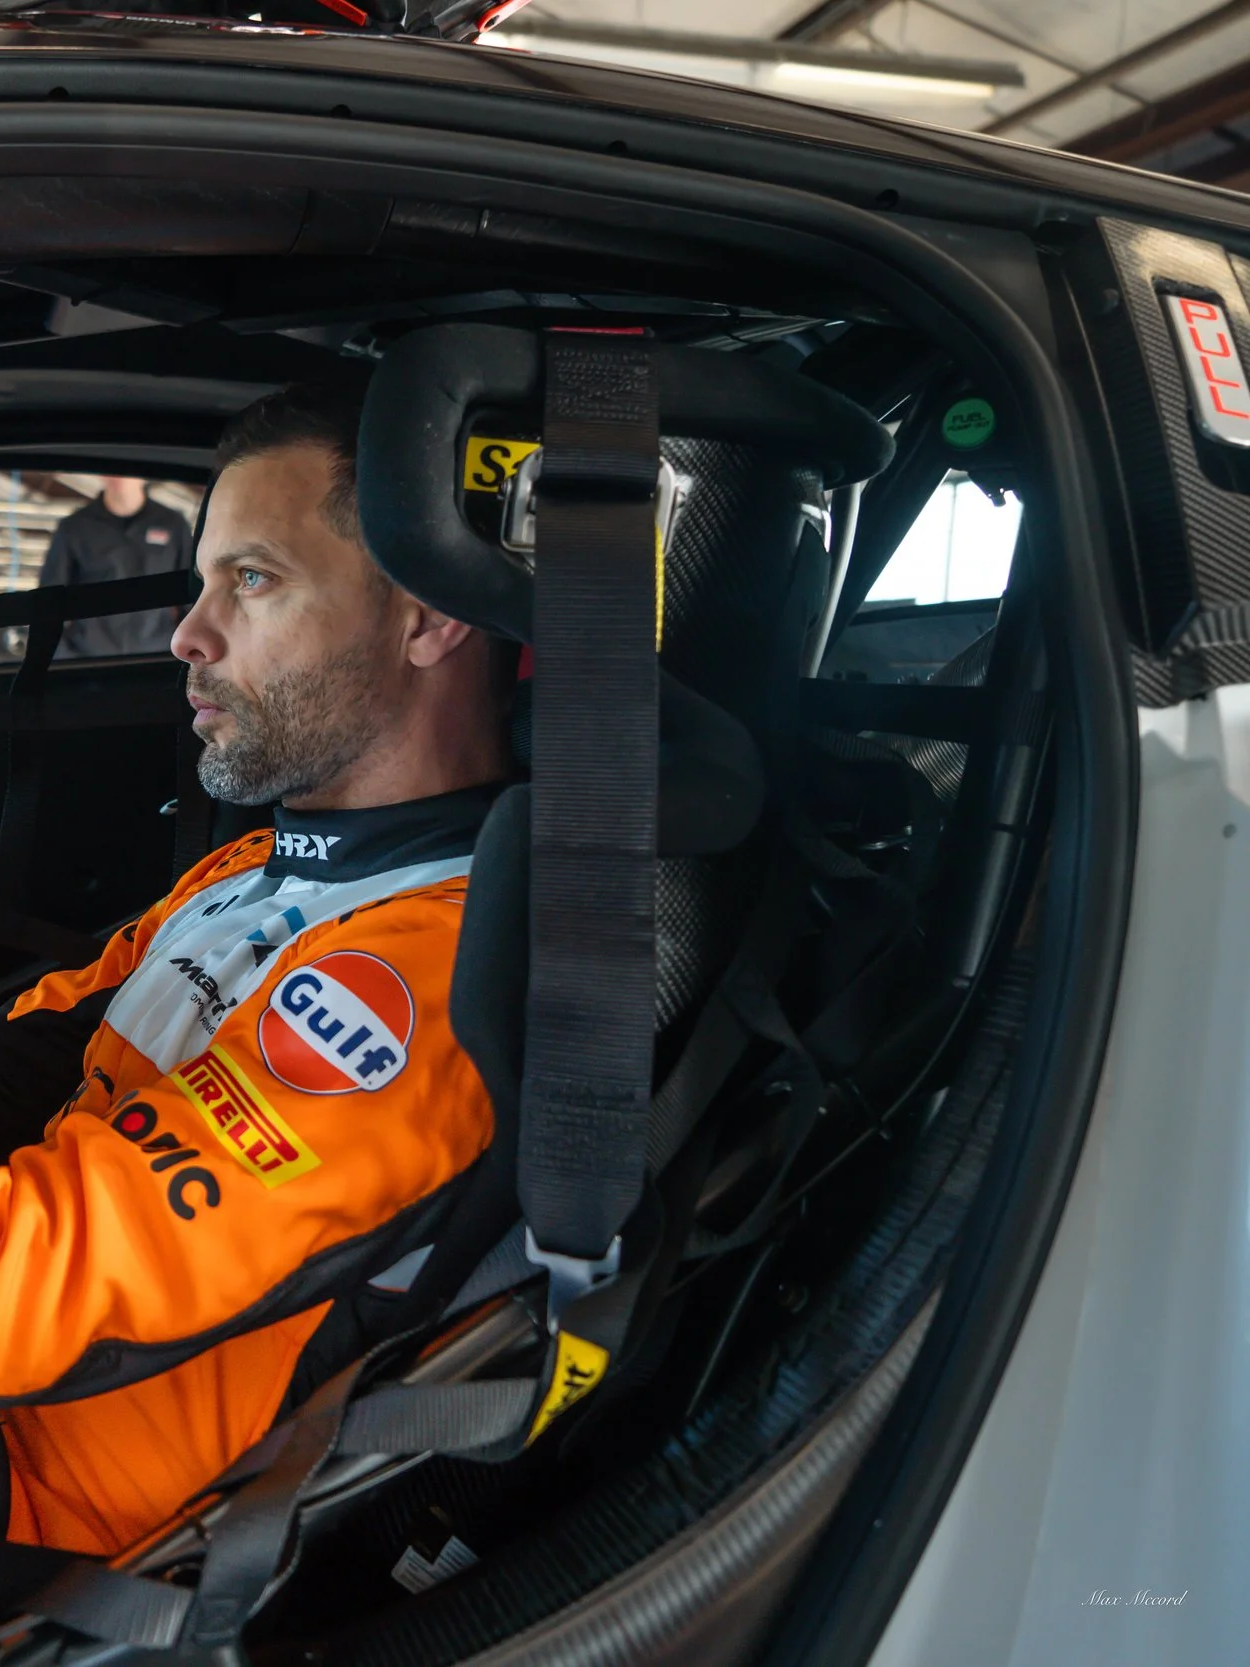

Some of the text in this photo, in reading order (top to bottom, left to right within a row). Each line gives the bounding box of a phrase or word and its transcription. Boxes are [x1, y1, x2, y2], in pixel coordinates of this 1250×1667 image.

[1179, 297, 1250, 420] PULL
[281, 973, 398, 1080] Gulf
[178, 1050, 299, 1173] PIRELLI
